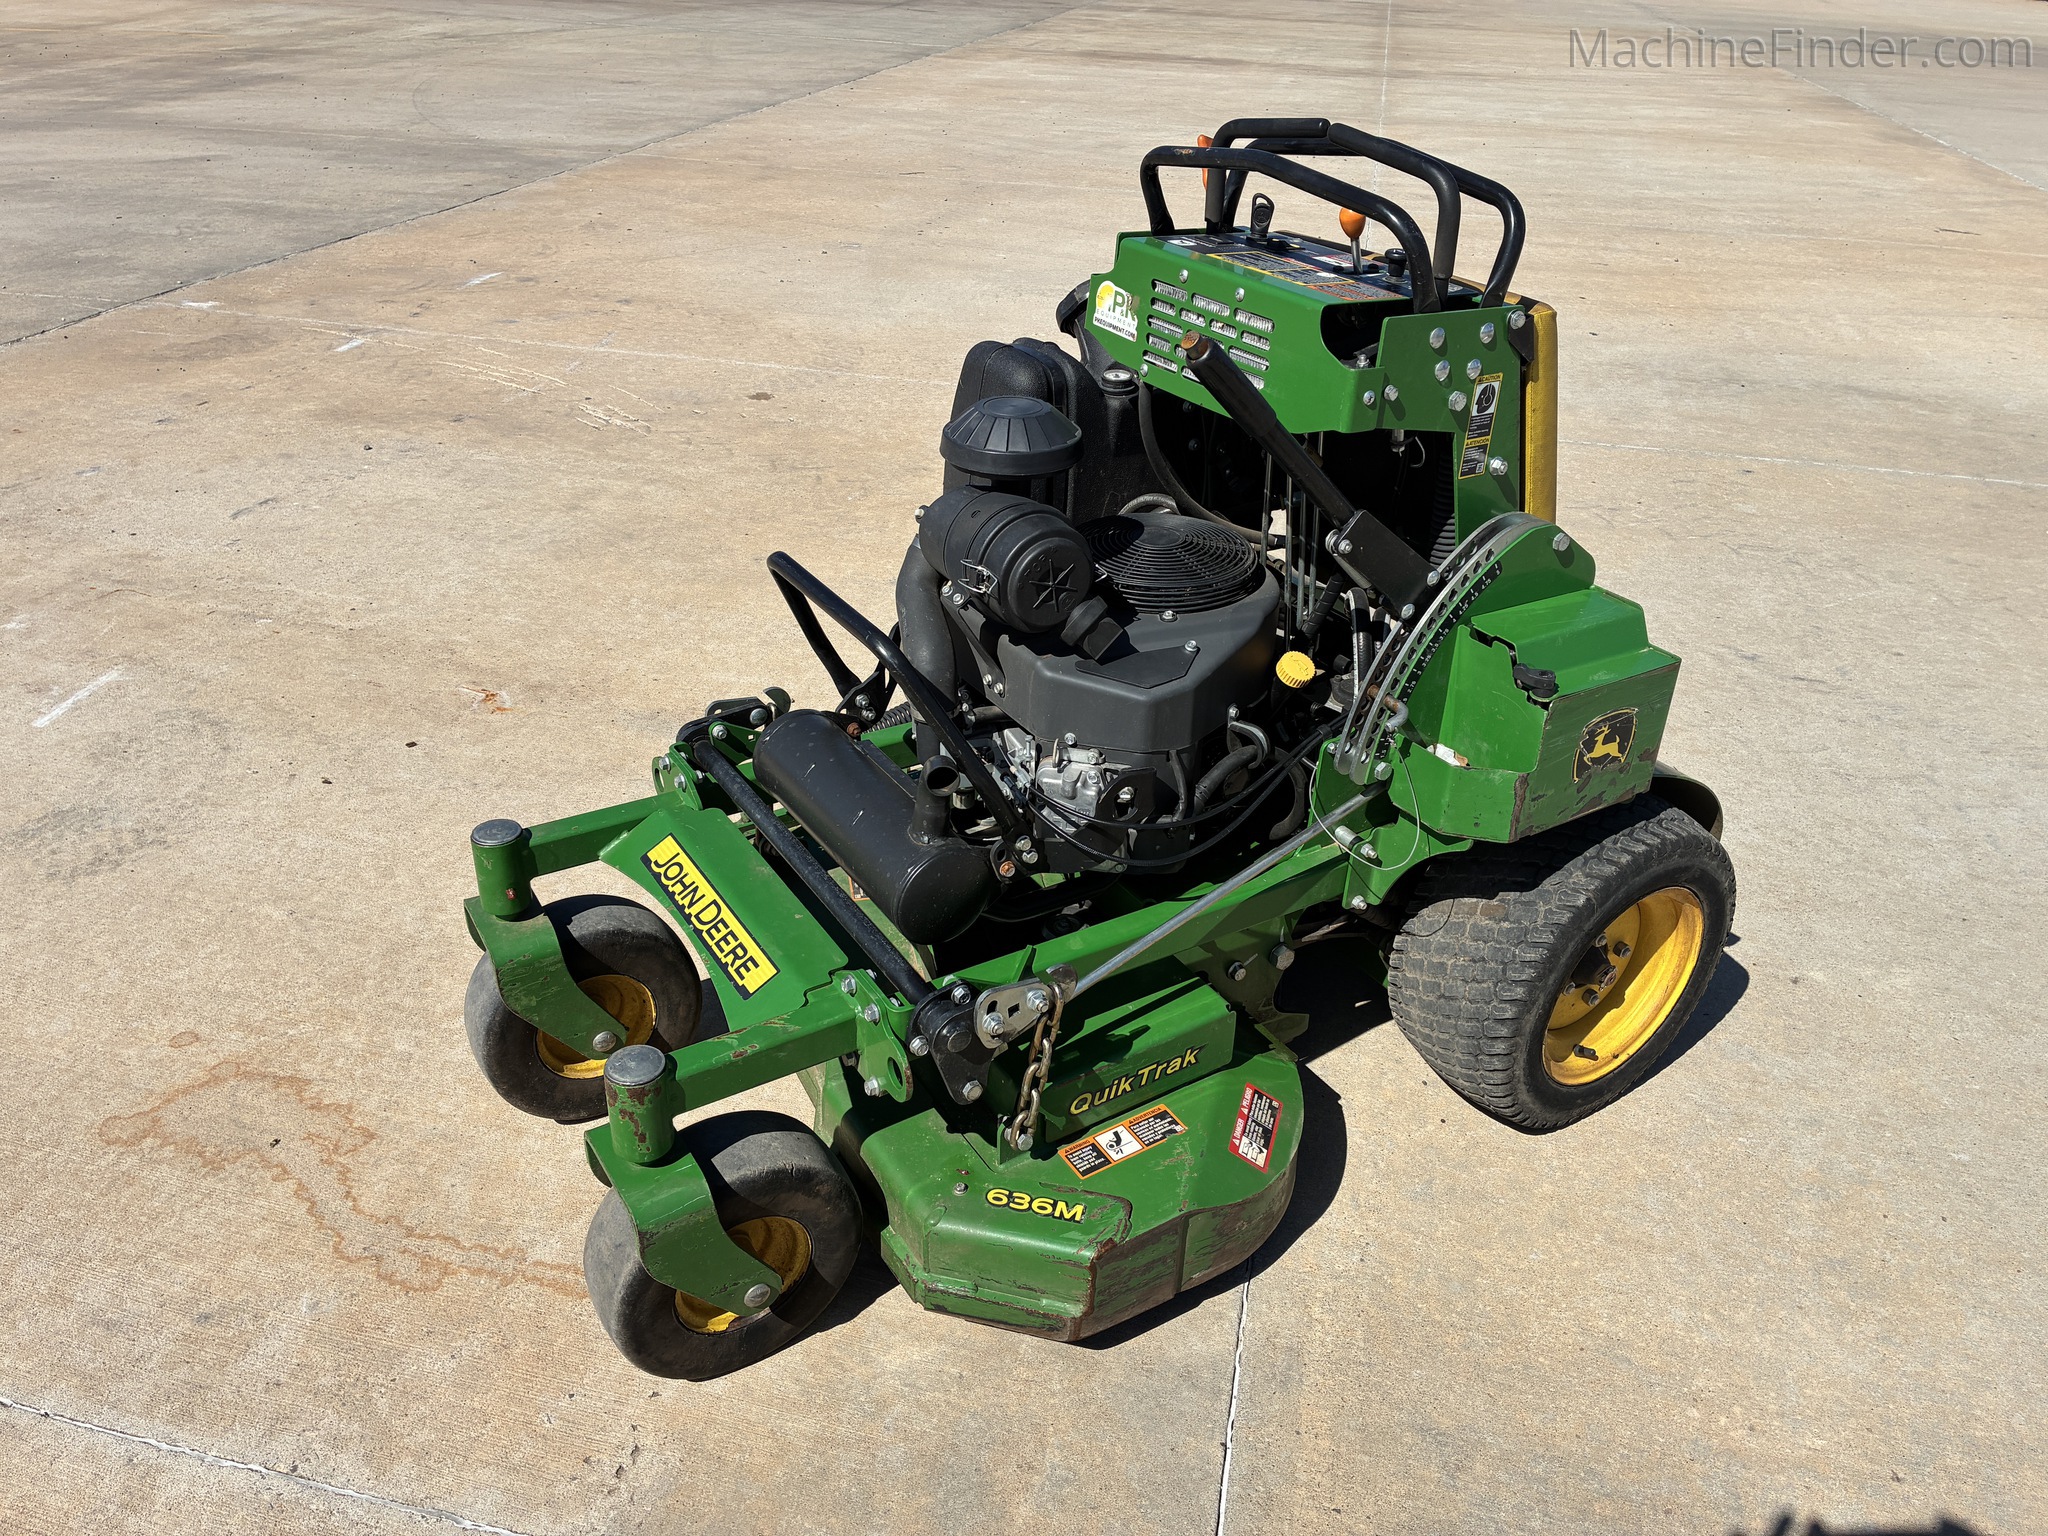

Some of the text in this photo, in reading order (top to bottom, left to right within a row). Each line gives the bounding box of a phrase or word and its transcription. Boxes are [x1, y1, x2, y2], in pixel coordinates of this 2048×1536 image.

[1097, 309, 1136, 330] EQUIPMENT
[653, 852, 760, 982] JOHN DEERE
[1242, 1087, 1253, 1108] PELIGRO
[1233, 1118, 1244, 1141] DANGER
[1069, 1139, 1091, 1152] WARNING
[985, 1187, 1086, 1223] 636M
